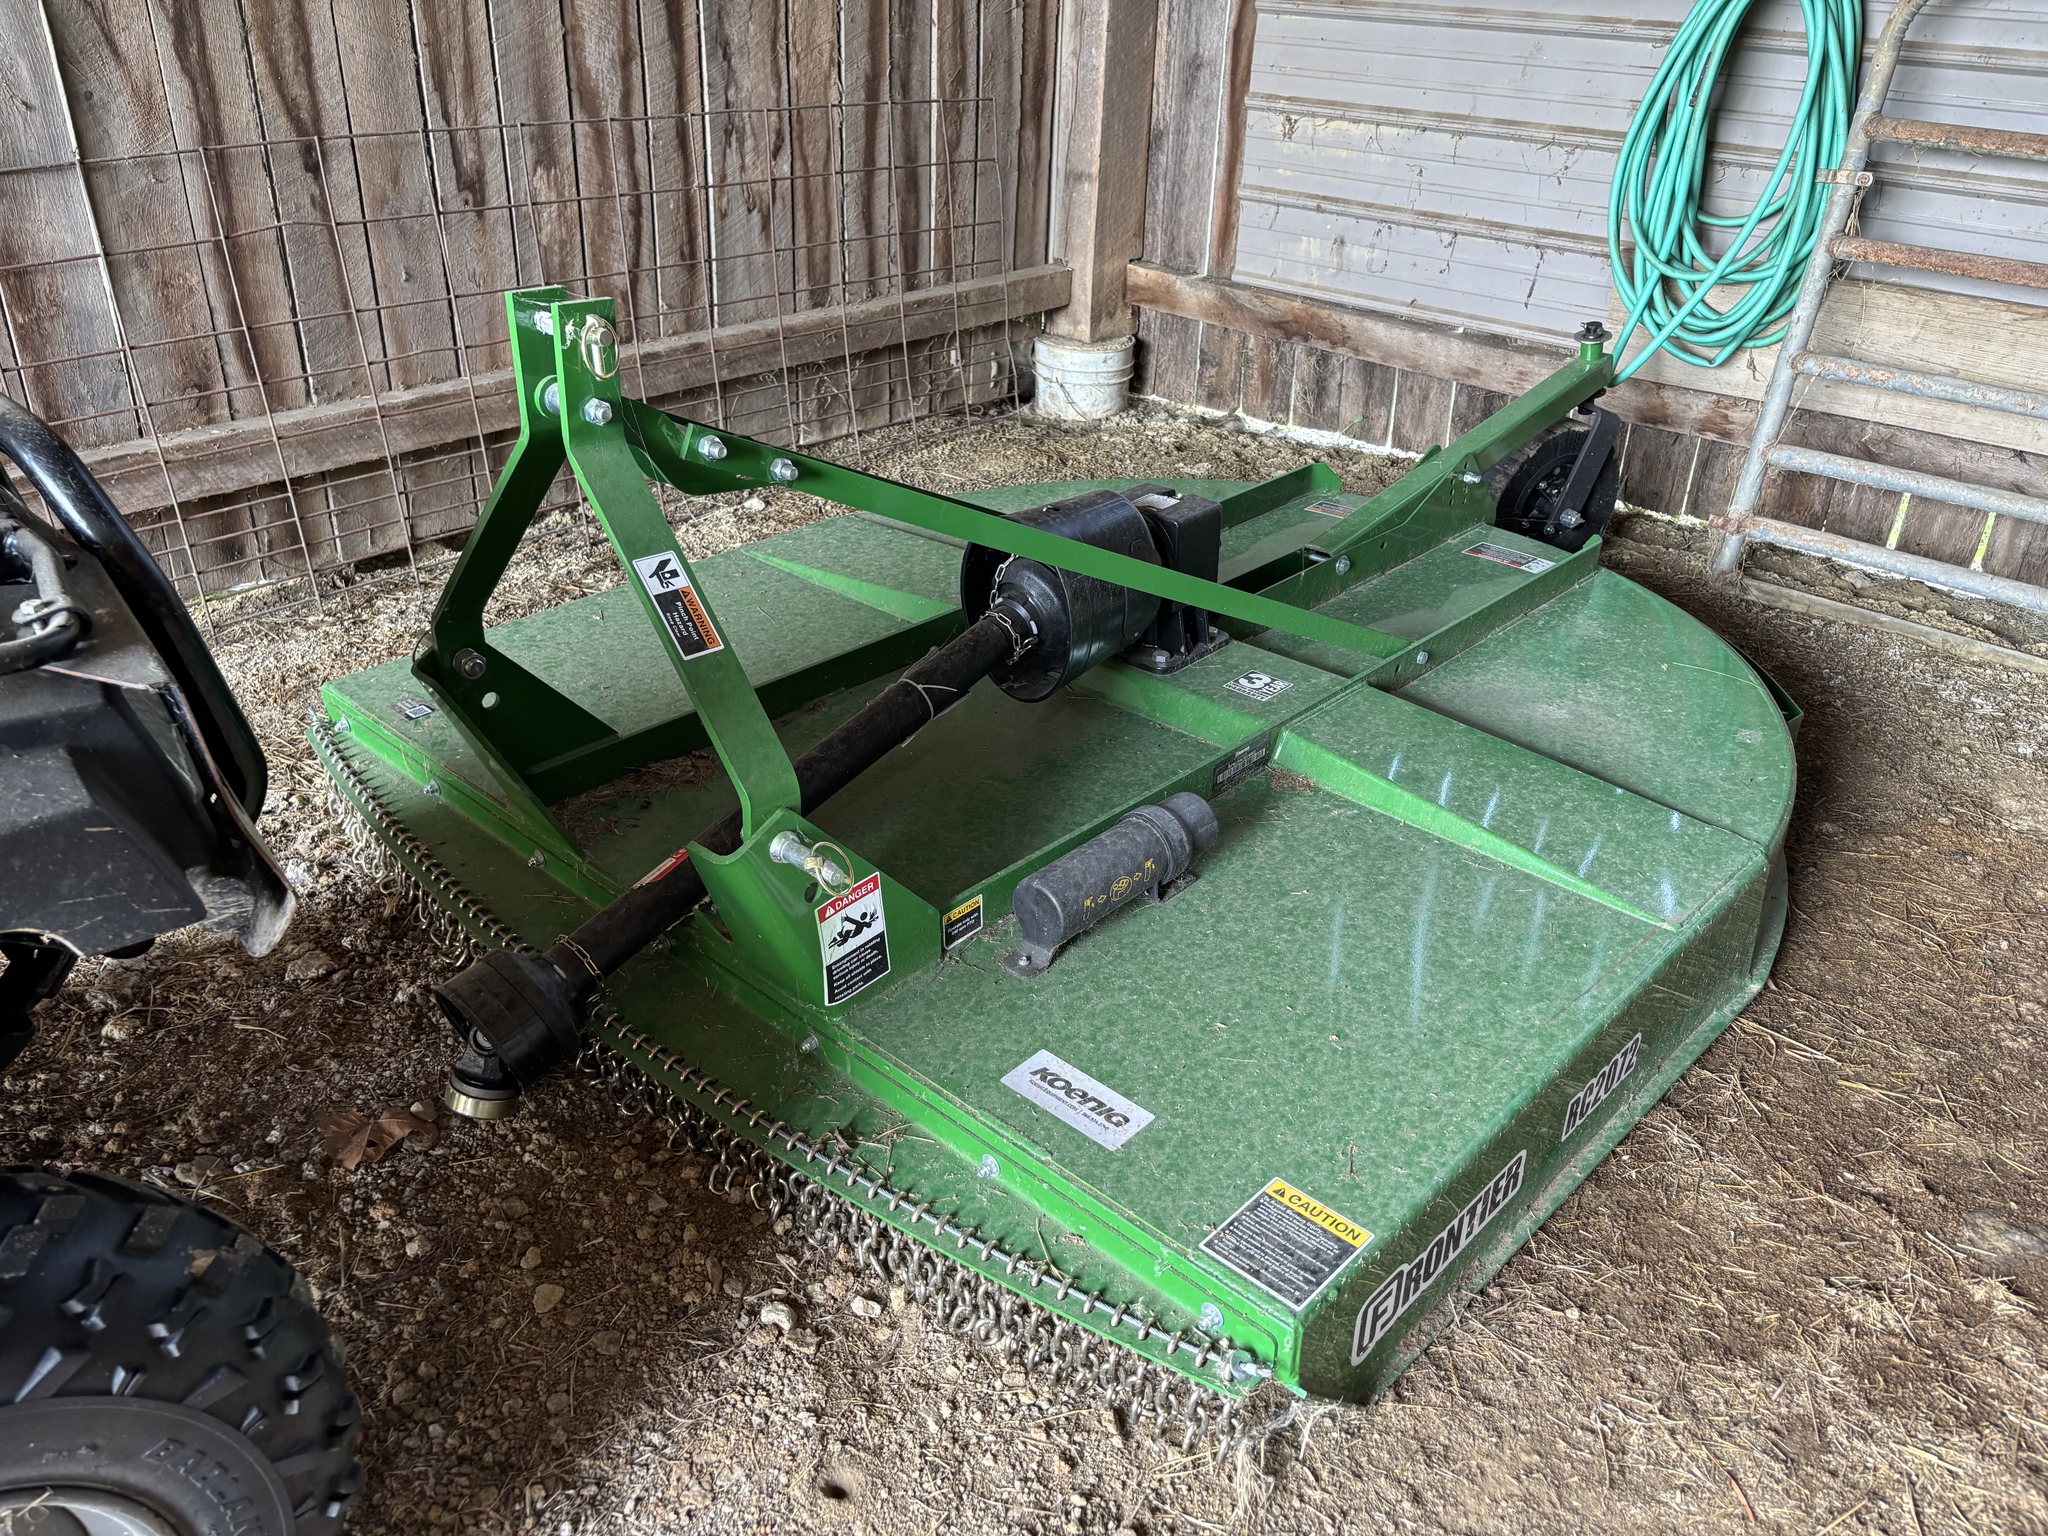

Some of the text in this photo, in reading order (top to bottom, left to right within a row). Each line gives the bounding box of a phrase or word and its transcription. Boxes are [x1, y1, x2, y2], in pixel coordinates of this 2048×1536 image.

[672, 612, 688, 636] Hazard
[675, 601, 699, 641] Pinch Point
[687, 598, 715, 645] WARNING
[1238, 673, 1272, 689] 3
[1261, 680, 1290, 696] YEAR
[835, 881, 874, 911] DANGER
[952, 899, 980, 919] CAUTION
[1565, 1036, 1640, 1134] RC2072
[1288, 1194, 1361, 1241] CAUTION
